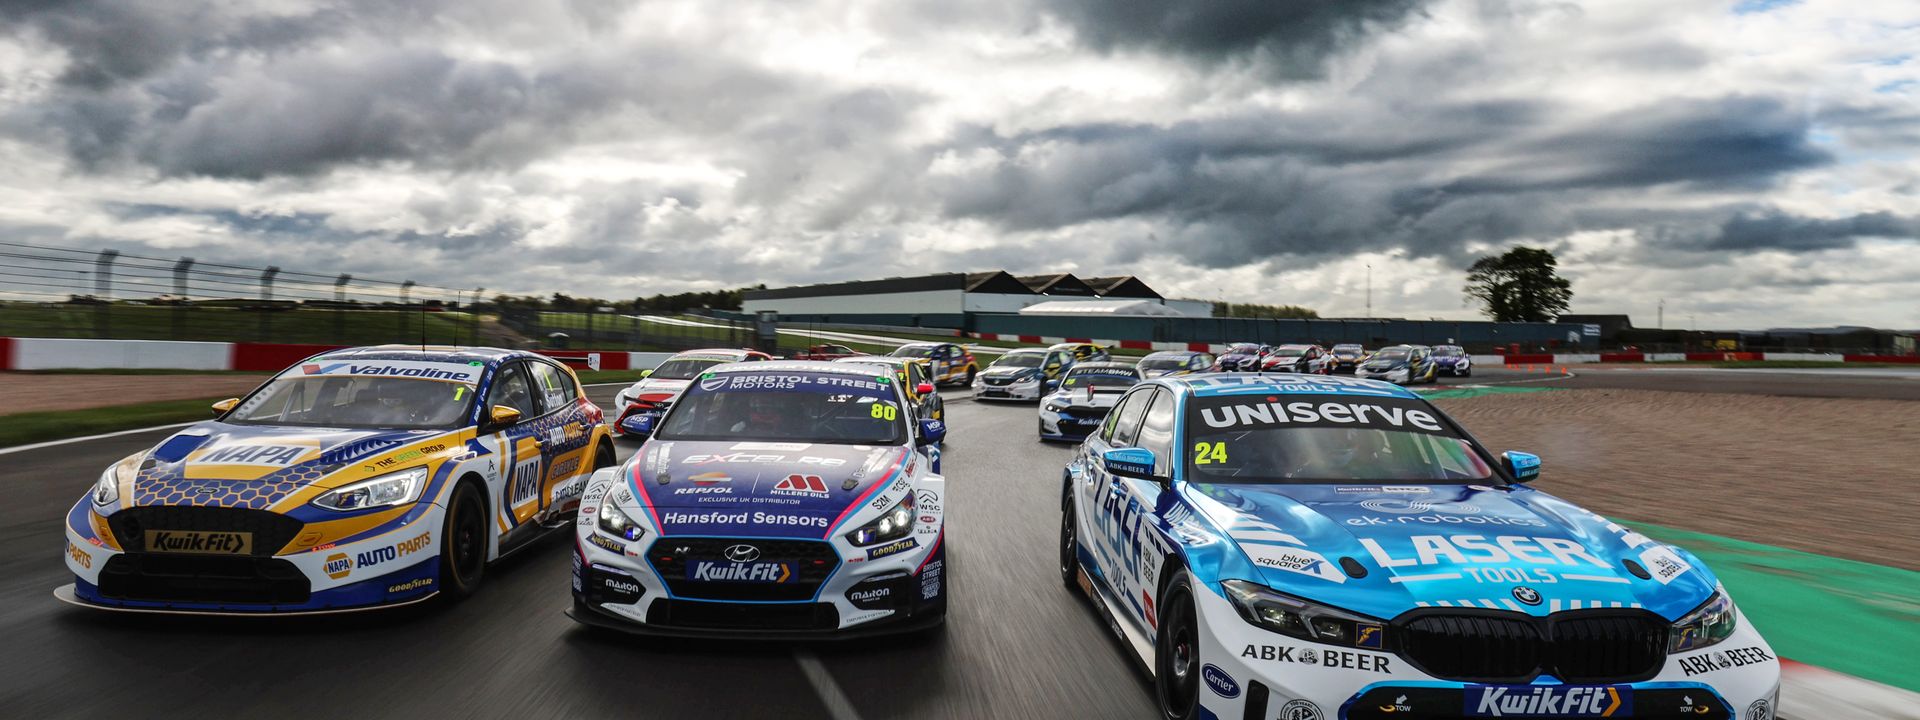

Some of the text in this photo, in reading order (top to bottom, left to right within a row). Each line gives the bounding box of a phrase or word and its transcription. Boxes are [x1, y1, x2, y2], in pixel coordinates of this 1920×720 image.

[350, 365, 470, 381] Valvoline
[732, 375, 890, 391] BRISTOL STREET
[1269, 384, 1338, 393] TOOLS
[454, 387, 464, 401] 1
[871, 403, 896, 421] 80
[200, 446, 306, 465] NAPA
[375, 457, 395, 469] THE
[420, 443, 446, 456] GROUP
[1194, 442, 1227, 465] 24
[513, 460, 539, 504] NAPA
[675, 487, 733, 495] REPSOL
[770, 490, 809, 498] MILLERS
[872, 494, 892, 511] S2M
[663, 512, 829, 527] Hansford Sensors
[69, 543, 93, 570] PARTS
[357, 531, 431, 569] AUTO PARTS
[872, 540, 914, 557] GOODYEAR
[1358, 535, 1617, 570] LASER
[327, 558, 350, 574] NAPA
[922, 560, 943, 572] BRISTOL
[1256, 557, 1302, 570] square
[1281, 553, 1311, 565] blue
[922, 568, 941, 581] STREET
[1110, 557, 1127, 597] TOOLS
[1462, 567, 1558, 584] TOOLS
[388, 578, 433, 593] GOODYEAR
[1241, 644, 1392, 674] ABK BEER
[1678, 646, 1774, 677] ABK BEER
[1205, 668, 1234, 693] Carrier
